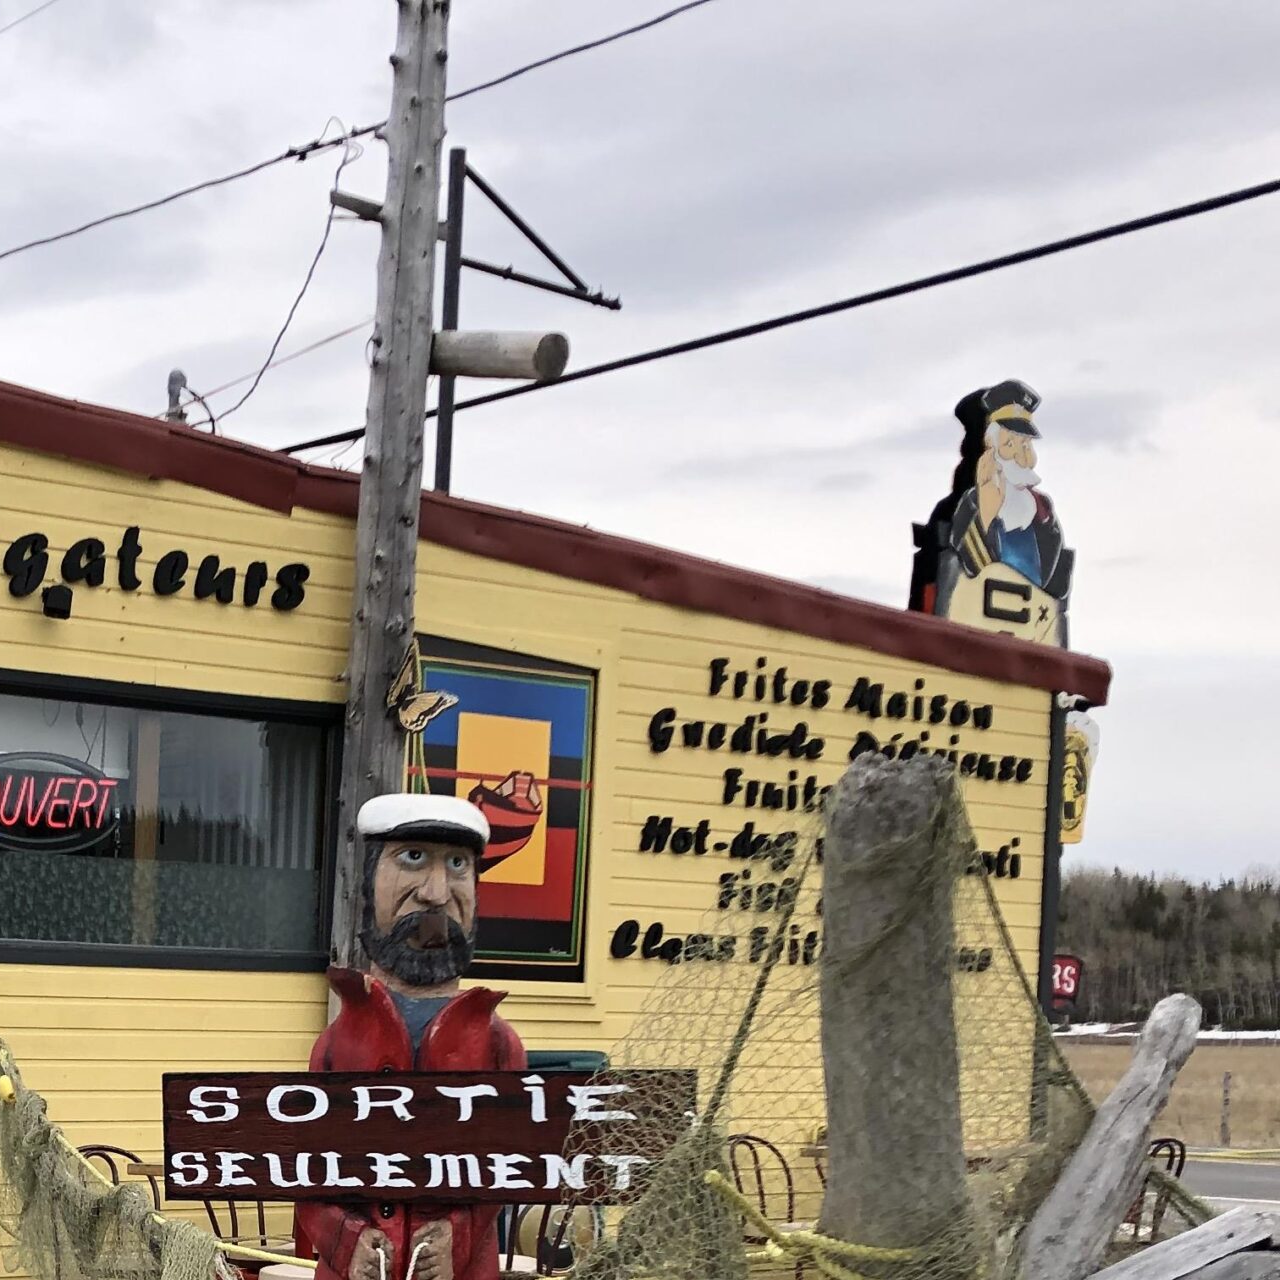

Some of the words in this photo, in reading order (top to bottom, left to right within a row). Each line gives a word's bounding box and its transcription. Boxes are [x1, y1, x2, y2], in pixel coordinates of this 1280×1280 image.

[710, 656, 832, 709] Frites
[844, 677, 993, 730] Maison
[639, 815, 798, 872] Hot-dog
[168, 1151, 651, 1190] SEULEMENT
